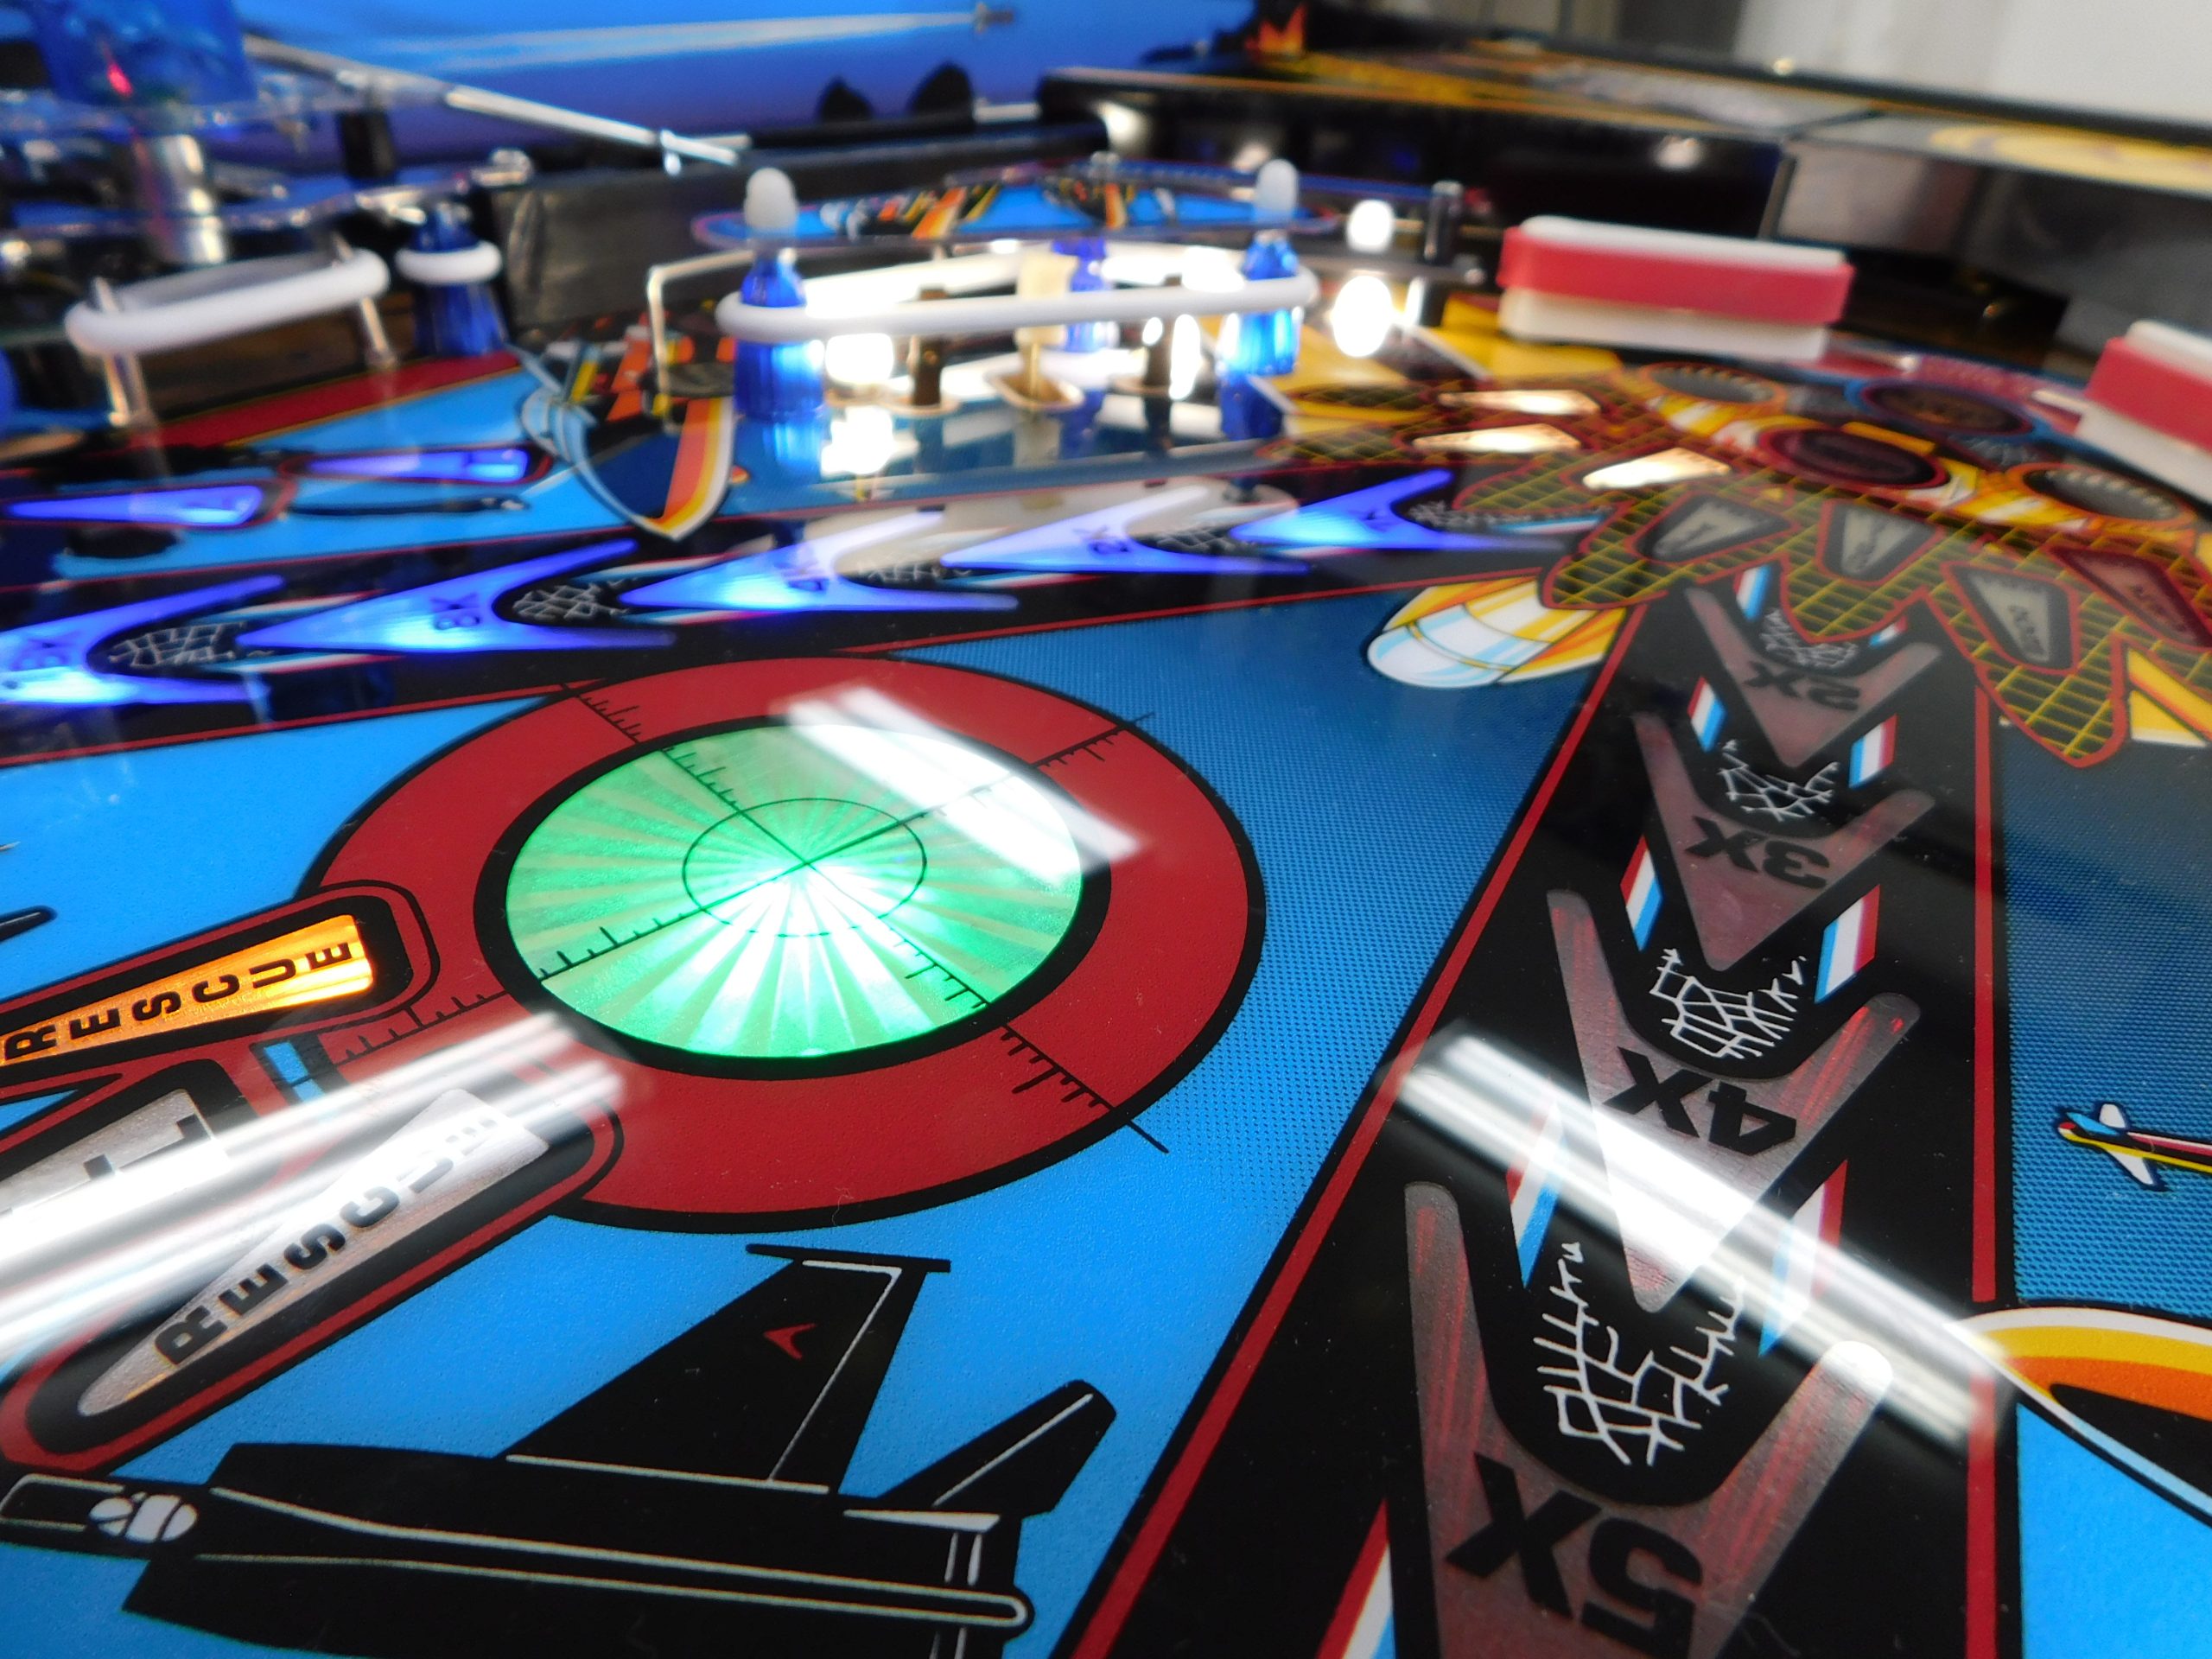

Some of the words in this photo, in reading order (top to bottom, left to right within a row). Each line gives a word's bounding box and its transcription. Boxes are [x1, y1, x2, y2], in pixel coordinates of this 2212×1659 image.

[1744, 661, 1860, 712] 2X
[1685, 816, 1830, 889] 3X
[4, 941, 354, 1061] RESCUE
[1603, 1046, 1797, 1157] 4X
[1444, 1452, 1704, 1659] 5X
